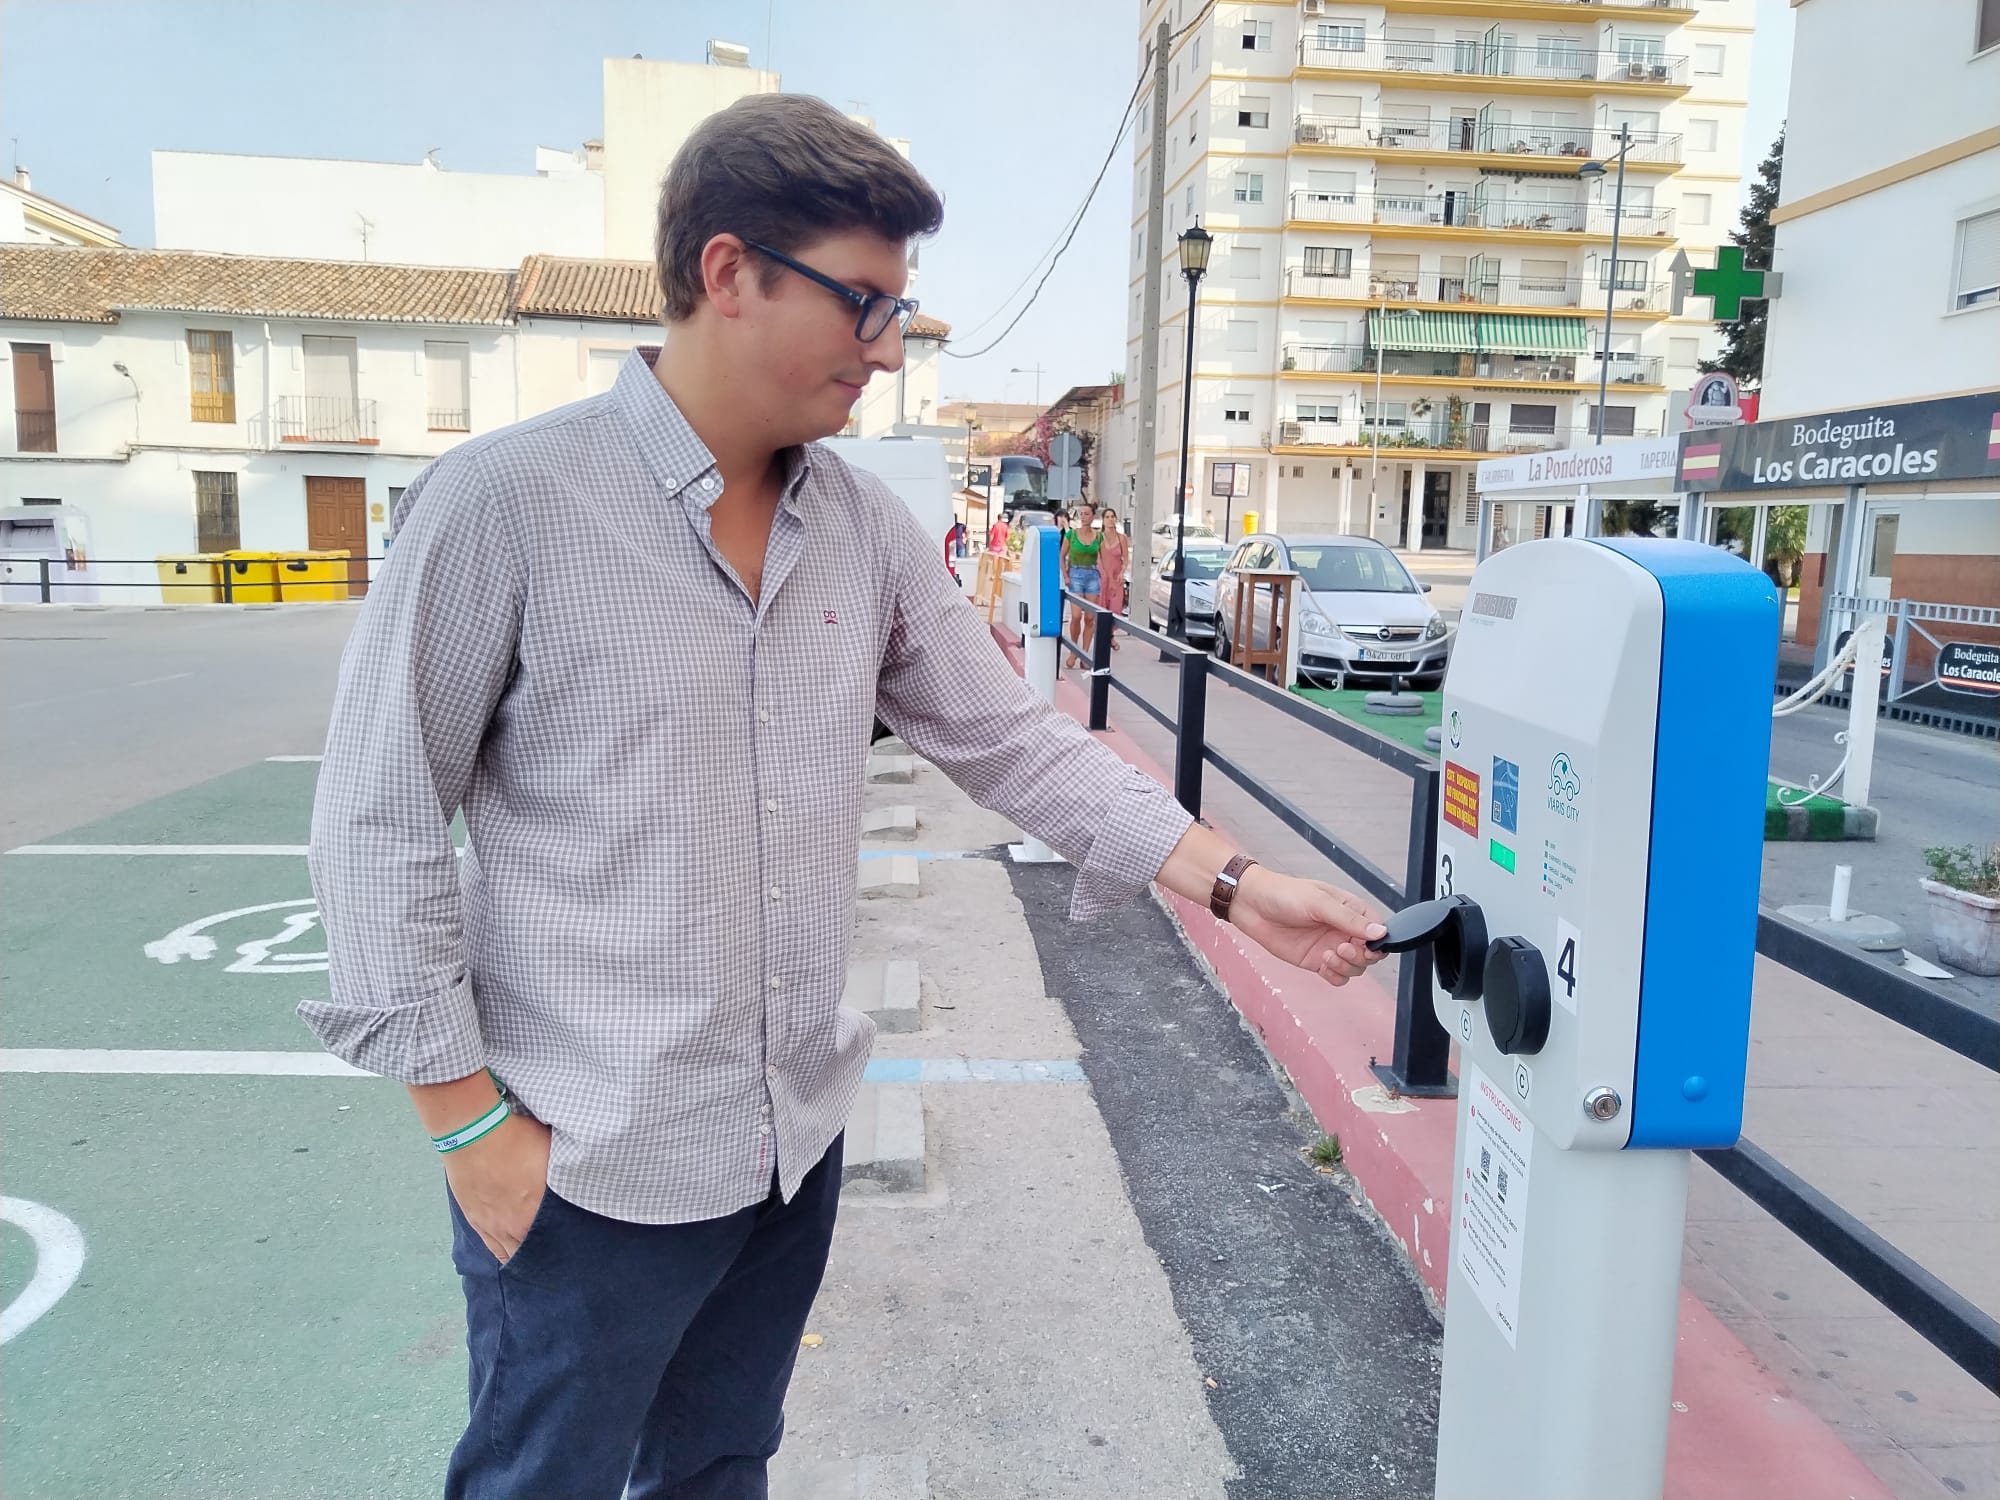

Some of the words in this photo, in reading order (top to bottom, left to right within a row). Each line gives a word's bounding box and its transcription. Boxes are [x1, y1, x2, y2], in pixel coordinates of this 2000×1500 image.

[1791, 416, 1896, 449] Bodeguita
[1528, 457, 1541, 482] La
[1545, 451, 1613, 480] Ponderosa
[1753, 457, 1793, 484] Los
[1799, 443, 1938, 481] Caracoles
[1954, 647, 1999, 665] Bodeguita
[1943, 663, 1960, 677] Los
[1960, 665, 2000, 683] Caracole
[1566, 805, 1580, 823] CITY
[1441, 854, 1453, 898] 3
[1557, 937, 1576, 998] 4
[1519, 1073, 1525, 1089] C
[1480, 1080, 1522, 1133] INSTRUCCIONES
